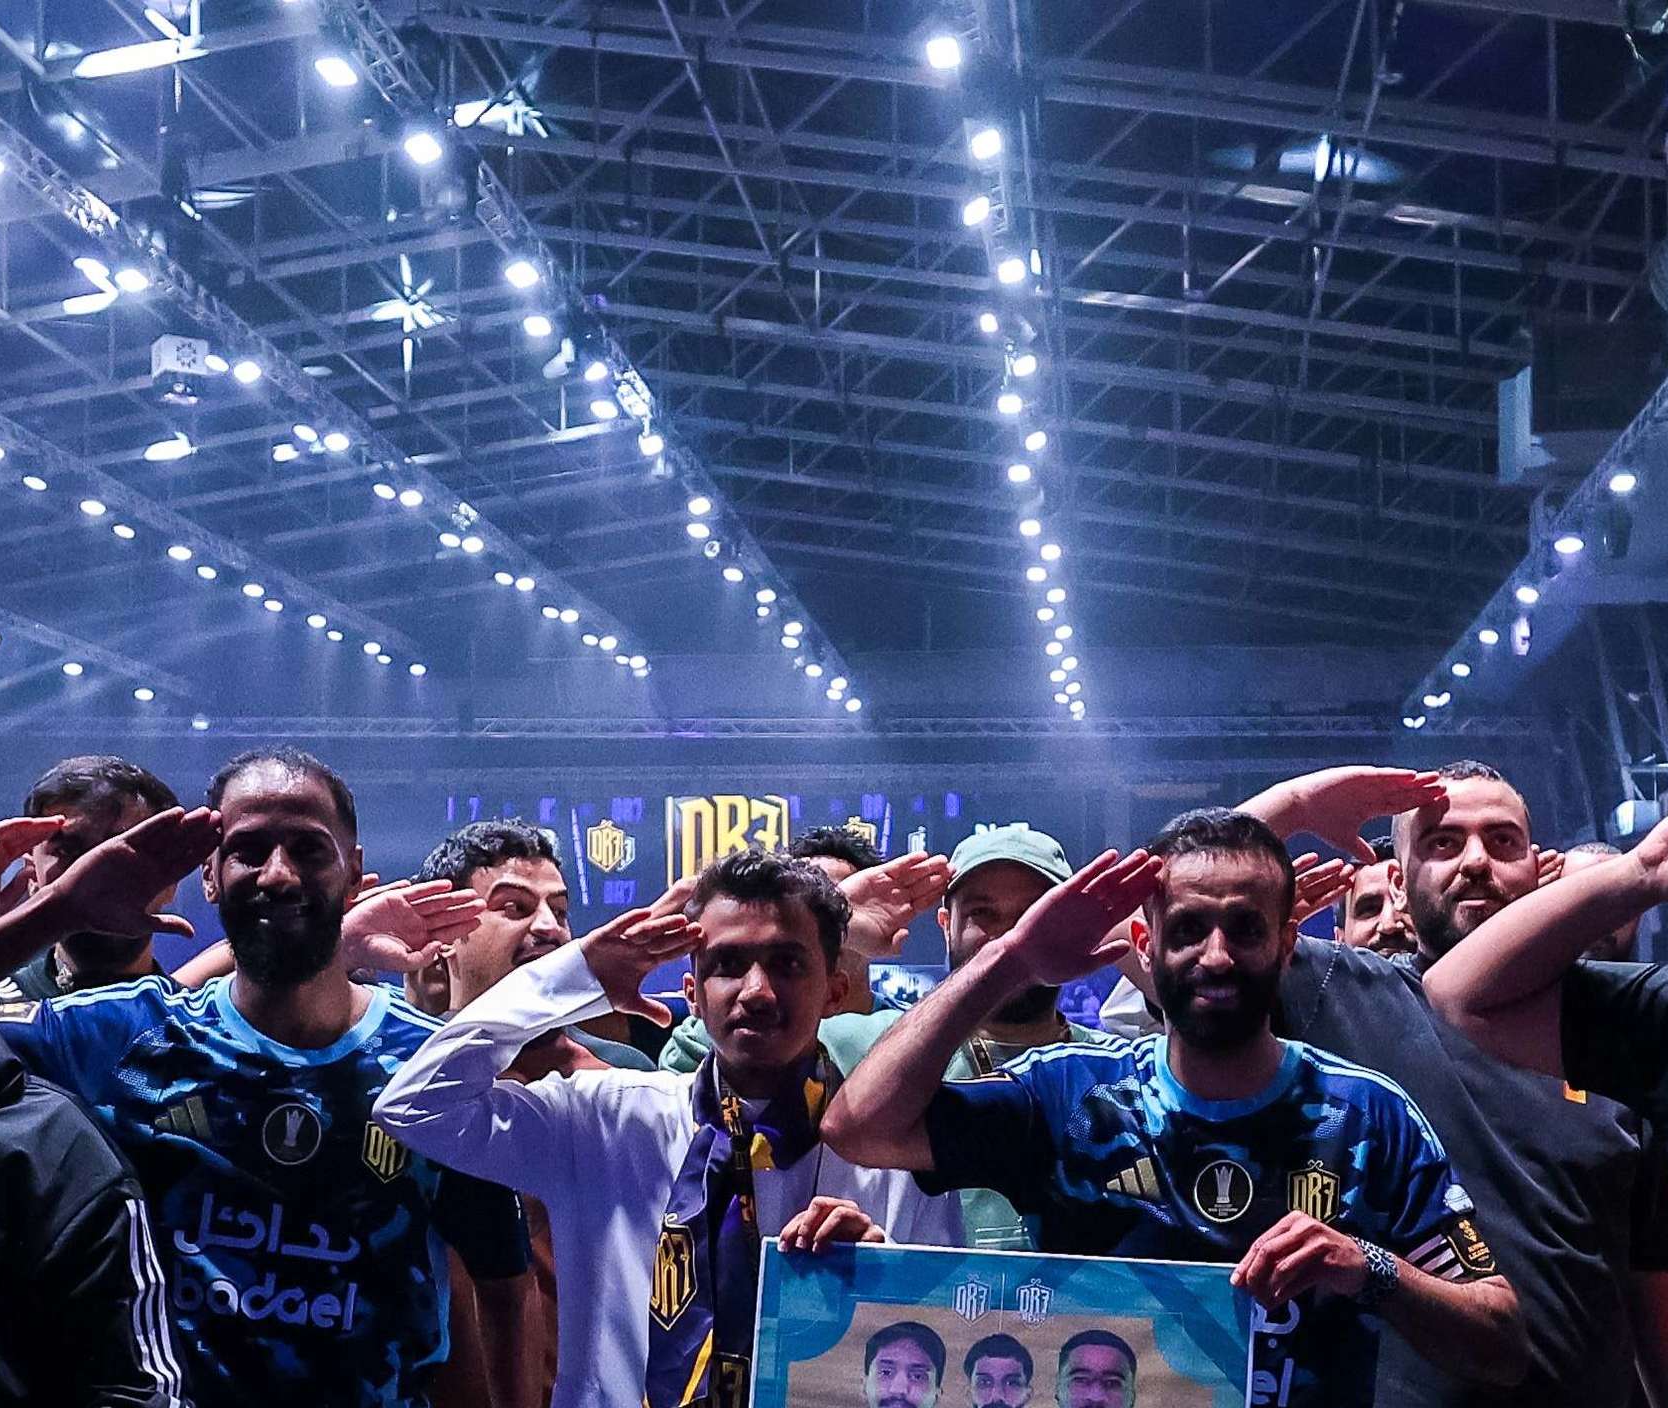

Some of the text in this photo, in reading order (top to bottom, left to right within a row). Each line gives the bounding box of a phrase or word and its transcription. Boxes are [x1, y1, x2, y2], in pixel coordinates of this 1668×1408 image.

[367, 1125, 405, 1178] DR
[1292, 1170, 1340, 1222] DR7
[173, 1262, 358, 1332] badael
[955, 1283, 988, 1321] DR7
[1019, 1287, 1050, 1313] DR7
